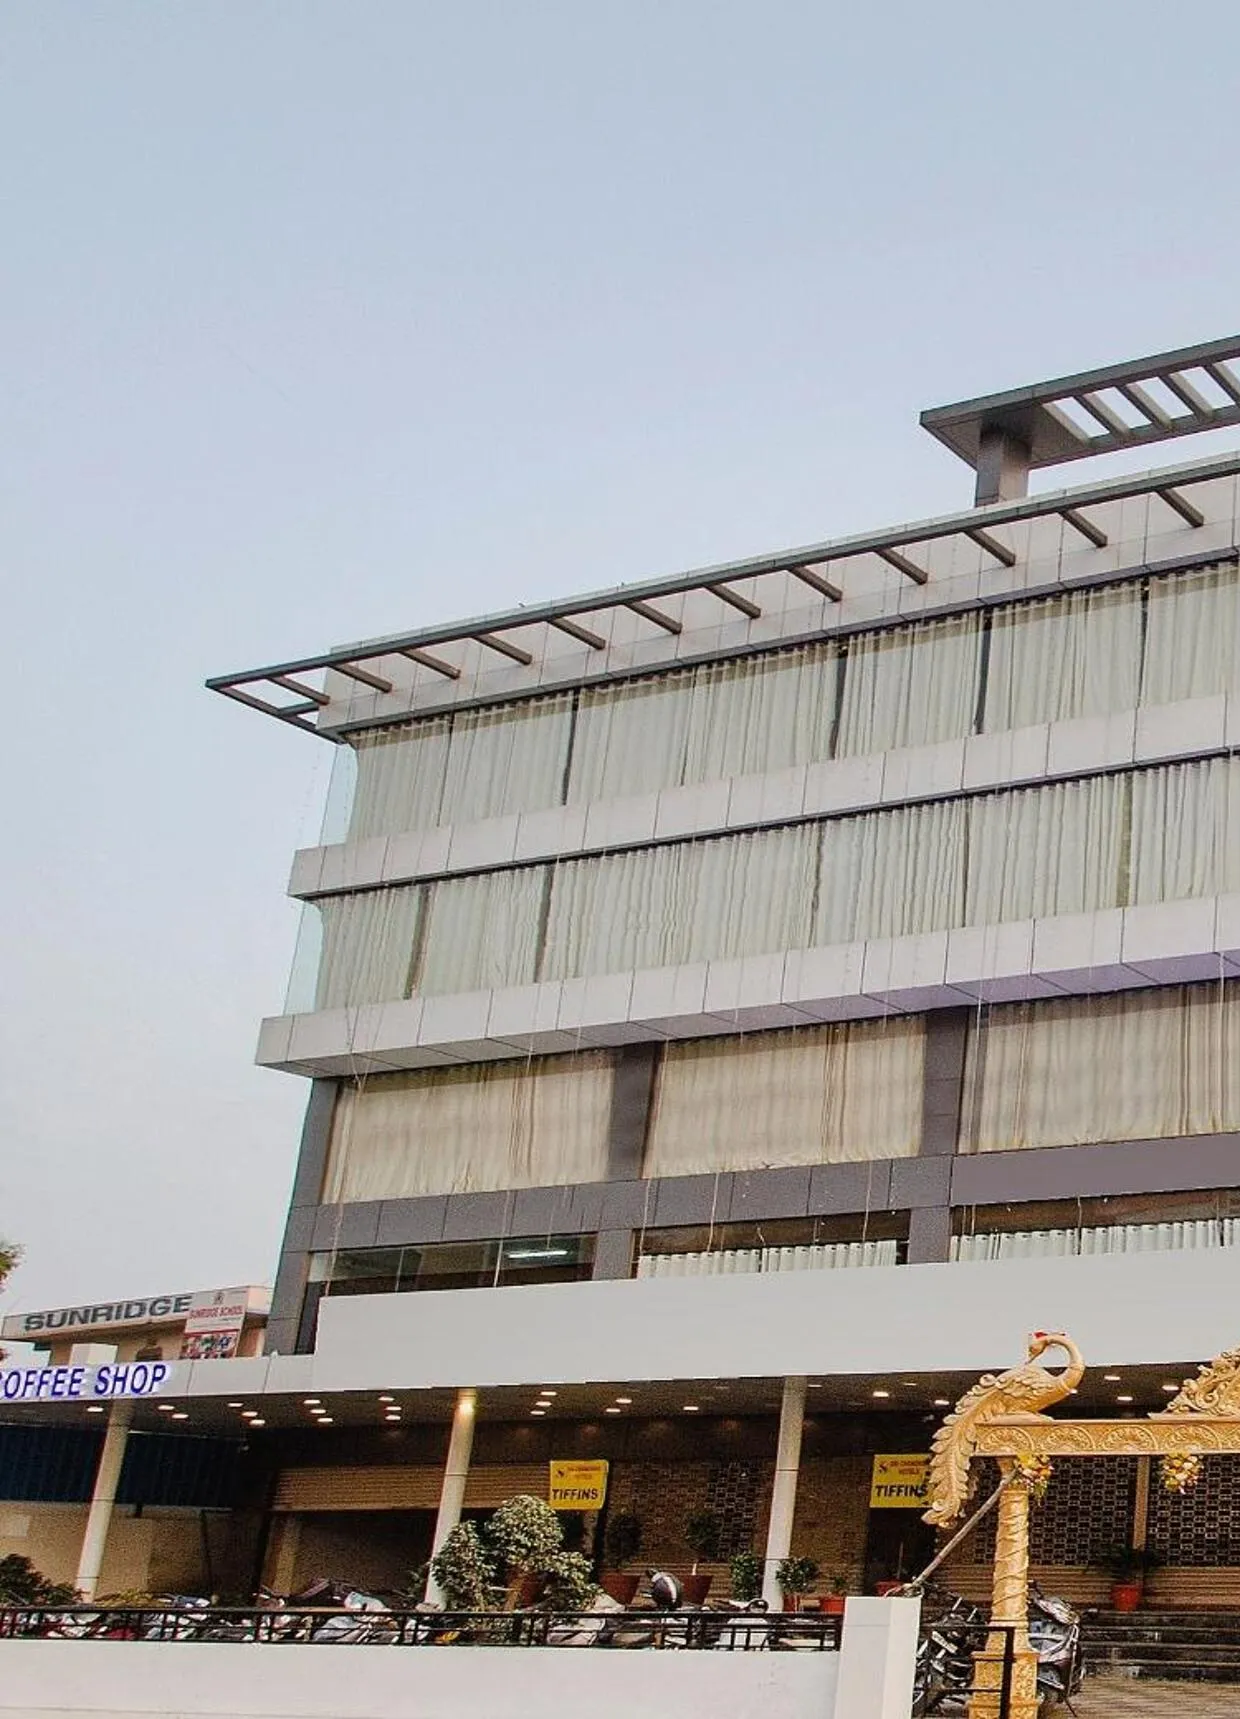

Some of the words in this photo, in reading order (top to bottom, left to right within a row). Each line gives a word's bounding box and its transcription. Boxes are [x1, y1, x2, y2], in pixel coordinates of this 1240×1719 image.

[24, 1295, 193, 1332] SUNRIDGE
[0, 1367, 85, 1399] OFFEE
[94, 1364, 167, 1395] SHOP
[552, 1488, 599, 1501] TIFFINS
[875, 1484, 929, 1497] TIFFINS
